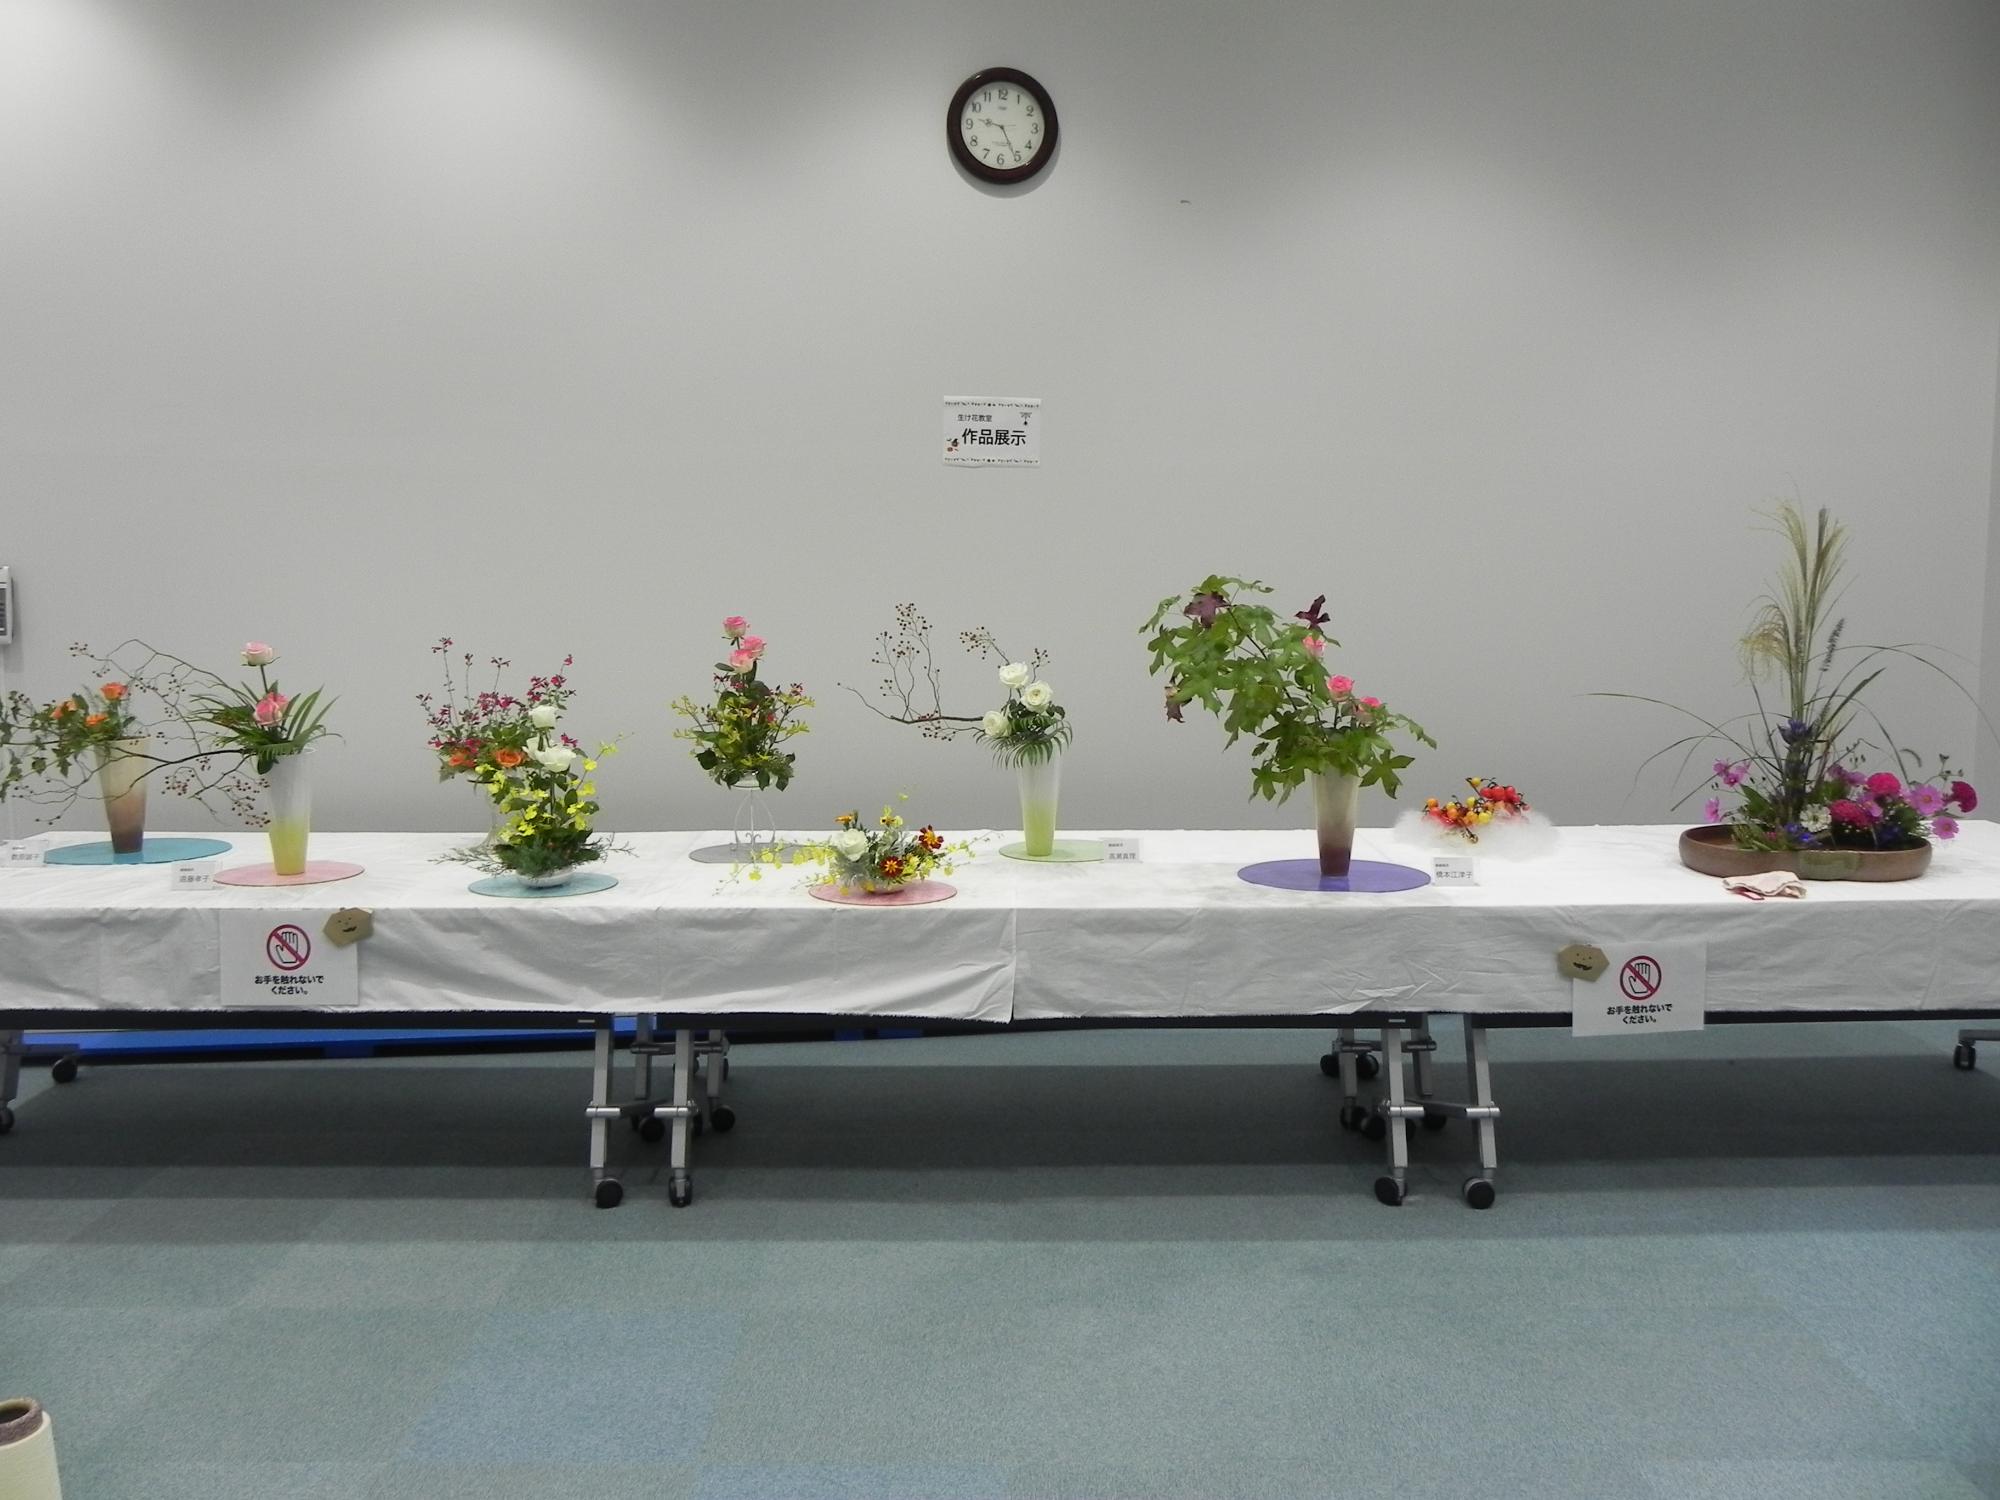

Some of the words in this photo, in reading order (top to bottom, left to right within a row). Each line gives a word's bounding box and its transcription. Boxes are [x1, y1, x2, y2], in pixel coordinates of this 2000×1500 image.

[983, 91, 992, 102] 11
[998, 88, 1008, 100] 12
[971, 102, 982, 113] 10
[1025, 105, 1034, 117] 2
[965, 118, 974, 130] 9
[1030, 122, 1039, 134] 3
[969, 135, 978, 147] 8
[1024, 140, 1032, 149] 4
[982, 148, 990, 159] 7
[1014, 151, 1021, 162] 5
[996, 154, 1005, 165] 6
[962, 428, 1026, 446] 作品展示
[254, 975, 324, 984] お手を触れないで
[271, 986, 308, 995] ください。
[1606, 1003, 1673, 1015] お手を触れないで
